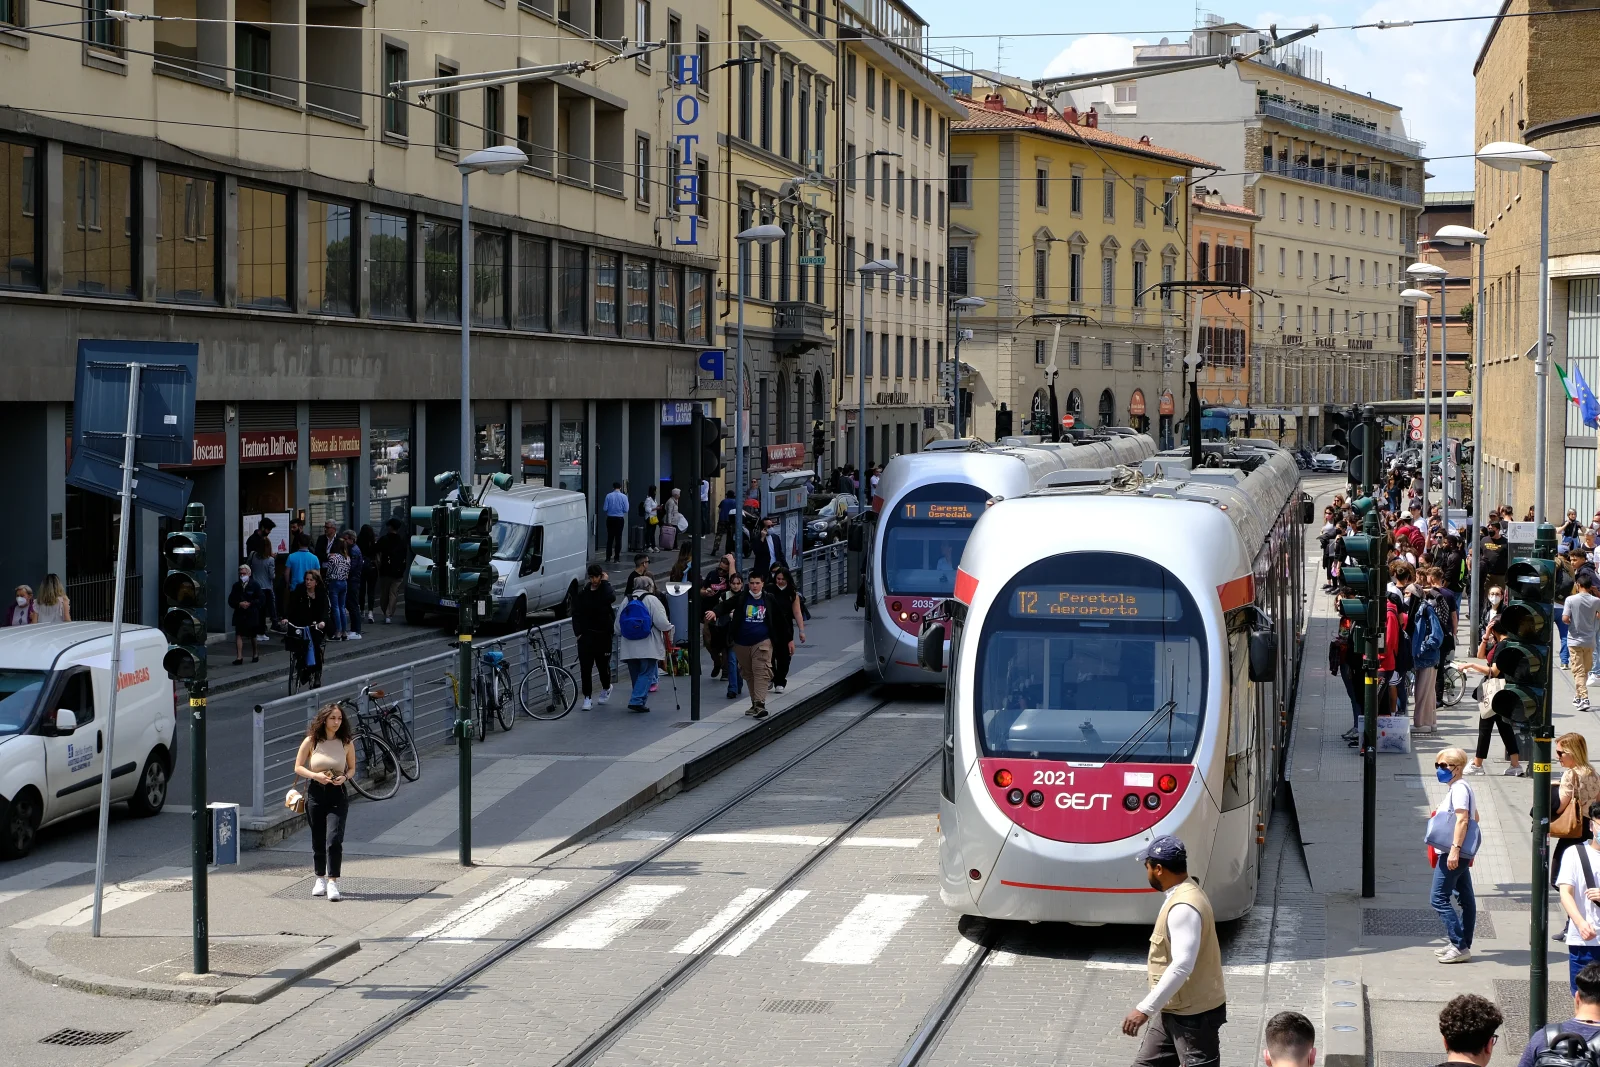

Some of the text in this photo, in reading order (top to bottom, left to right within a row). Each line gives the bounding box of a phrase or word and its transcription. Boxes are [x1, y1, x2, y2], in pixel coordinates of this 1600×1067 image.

[806, 149, 823, 251] HOTEL
[800, 257, 826, 265] AURORA
[675, 402, 692, 413] GARA
[193, 439, 224, 461] Toscana
[241, 435, 297, 458] Trattoria Dall'oste
[310, 435, 360, 453] Bistecca alla Fiorentina
[906, 504, 917, 518] T1
[912, 600, 934, 608] 2035
[1019, 591, 1136, 614] T2 Peretola
[1050, 604, 1138, 616] Aeroporto
[1033, 770, 1075, 785] 2021
[1055, 792, 1112, 810] GEST
